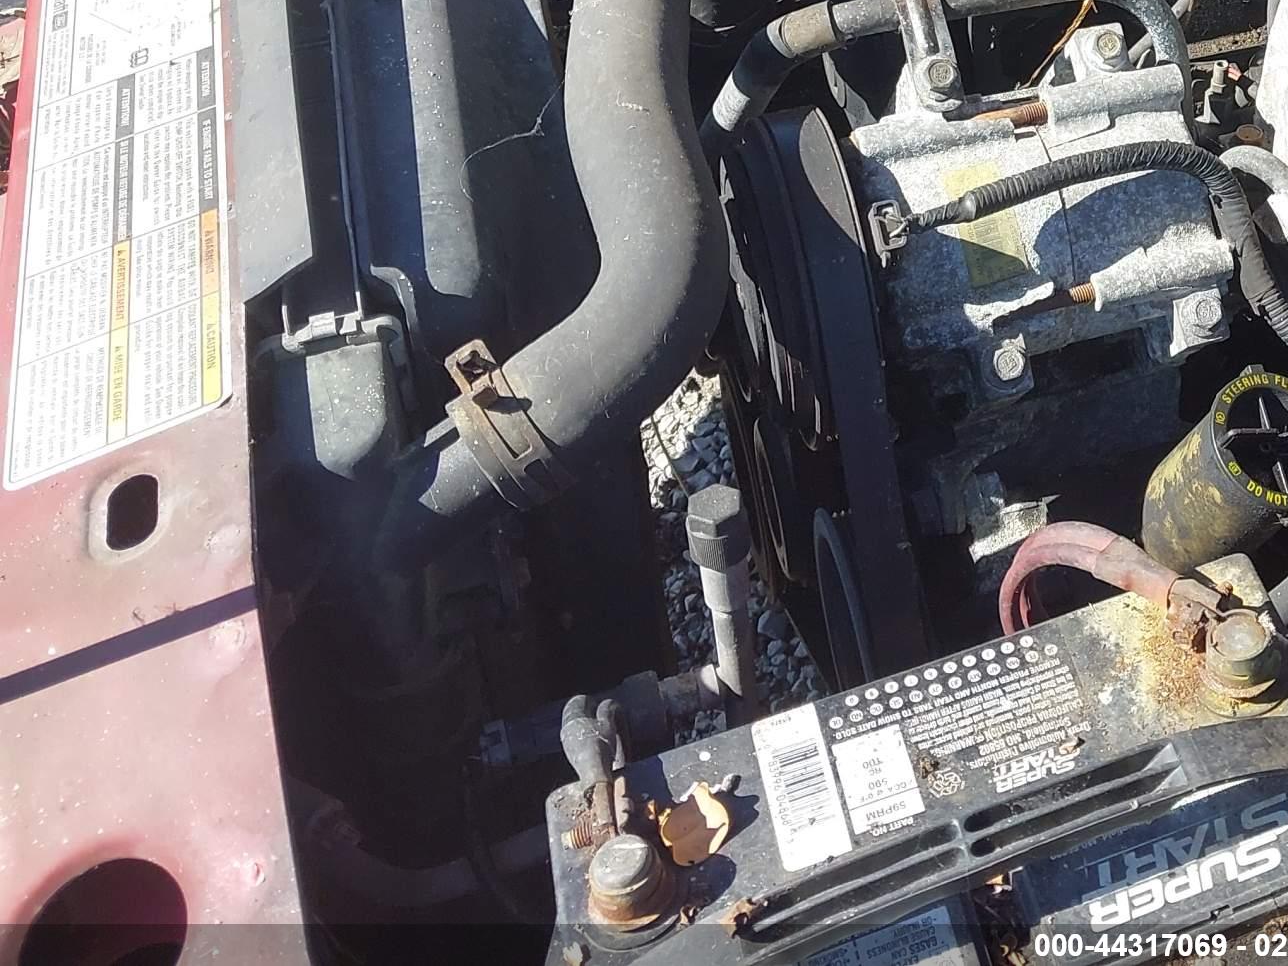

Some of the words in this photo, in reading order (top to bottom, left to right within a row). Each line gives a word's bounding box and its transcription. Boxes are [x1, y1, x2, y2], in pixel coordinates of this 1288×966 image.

[201, 59, 210, 97] ATTENTION
[202, 125, 211, 150] ENGINE
[202, 148, 212, 170] FAILS
[203, 167, 212, 179] TO
[203, 177, 213, 201] START
[204, 235, 214, 275] WARNING
[115, 255, 125, 323] AVERTISSEMENT
[205, 328, 215, 371] CAUTION
[113, 352, 123, 375] MISE
[113, 375, 122, 391] EN
[1221, 374, 1270, 404] STEERING
[112, 390, 122, 423] GARDE
[1246, 479, 1263, 497] DO
[1265, 491, 1288, 507] NOT
[998, 667, 1029, 684] PROPER
[1028, 657, 1060, 674] REMOVE
[954, 688, 970, 699] AND
[971, 677, 999, 694] MONTH
[912, 701, 933, 714] TABS
[933, 694, 954, 707] YEAR
[1036, 697, 1083, 722] CALIFORNIA
[877, 711, 901, 726] SHOW
[901, 708, 911, 718] TO
[856, 720, 877, 732] DATE
[982, 712, 1037, 741] PROPOSITION
[1021, 715, 1071, 741] Springfield,
[978, 737, 1005, 756] 65802
[1006, 732, 1021, 746] MO
[1017, 728, 1066, 754] Automotive
[965, 744, 1018, 771] Distributors,
[996, 760, 1076, 794] SUPER
[869, 825, 887, 837] NO.
[887, 816, 914, 831] PART
[1089, 845, 1282, 932] SUPER
[909, 926, 936, 942] CAUSE
[867, 936, 909, 959] BLINDNESS
[891, 948, 908, 960] CAN
[908, 938, 938, 953] GASES
